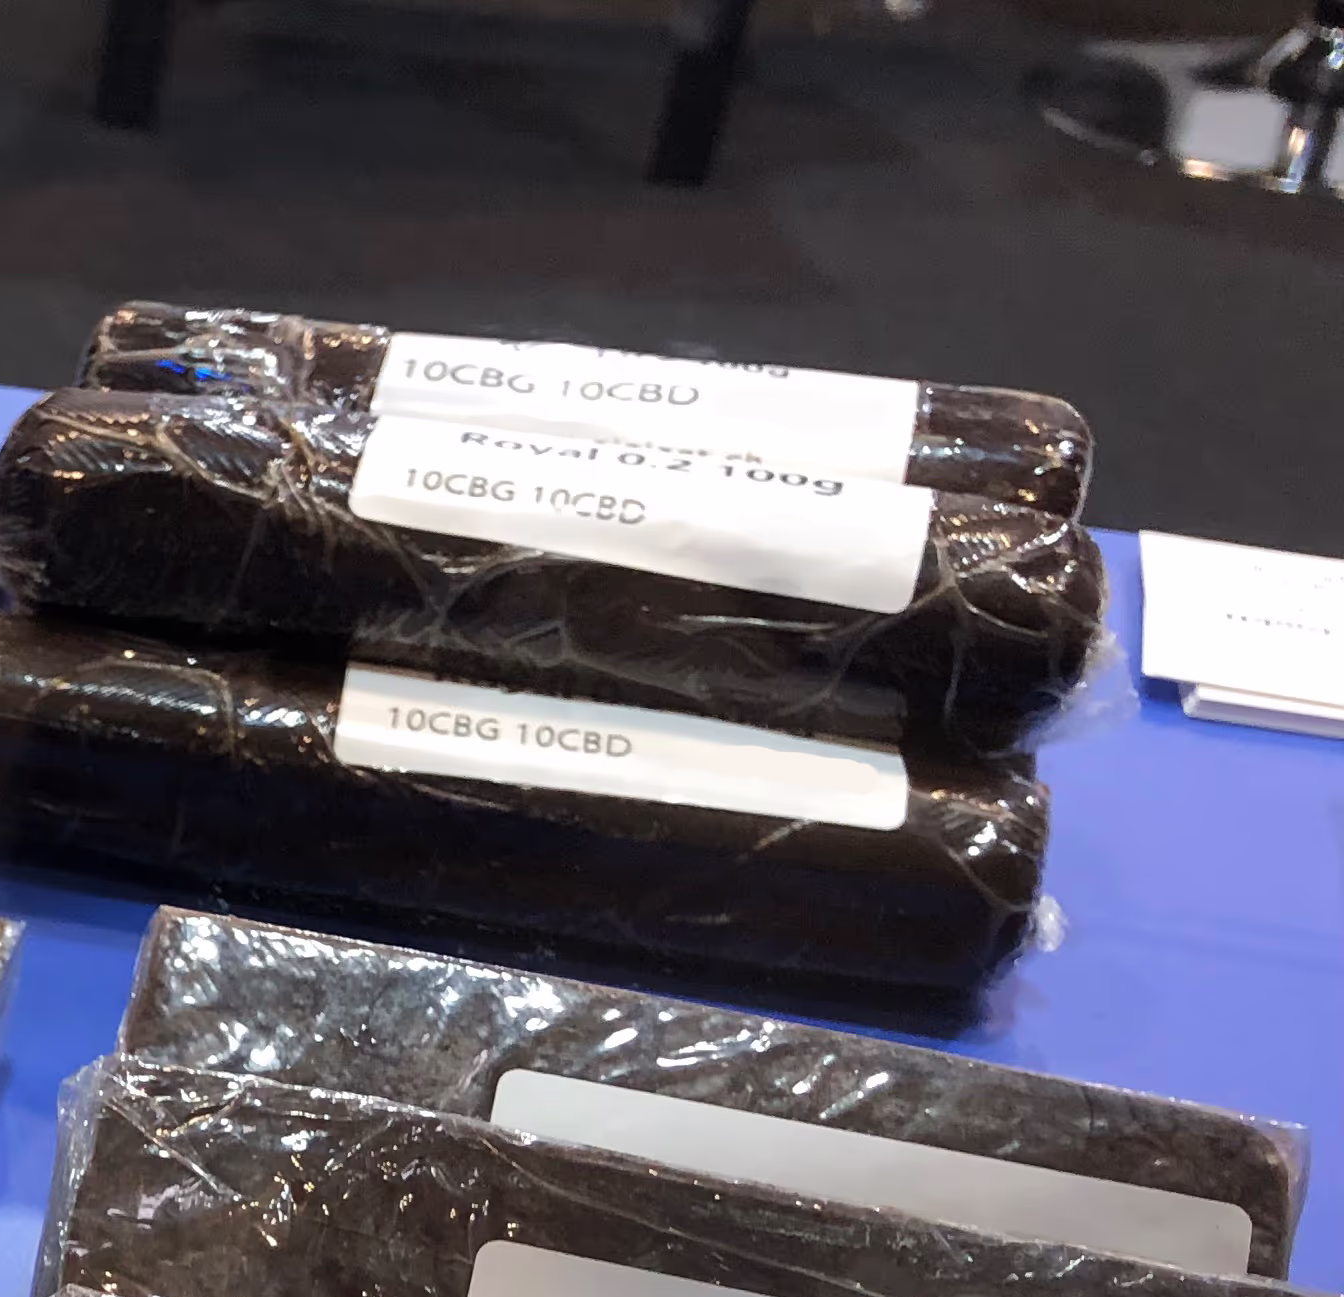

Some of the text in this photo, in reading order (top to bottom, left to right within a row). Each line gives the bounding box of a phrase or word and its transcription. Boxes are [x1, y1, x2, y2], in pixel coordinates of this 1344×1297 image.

[403, 358, 700, 406] 10CBG 10CBD
[406, 468, 647, 526] 10CBG 10CBD
[617, 452, 693, 473] 0.2
[721, 465, 845, 497] 100g
[389, 707, 634, 758] 10CBG 10CBD
